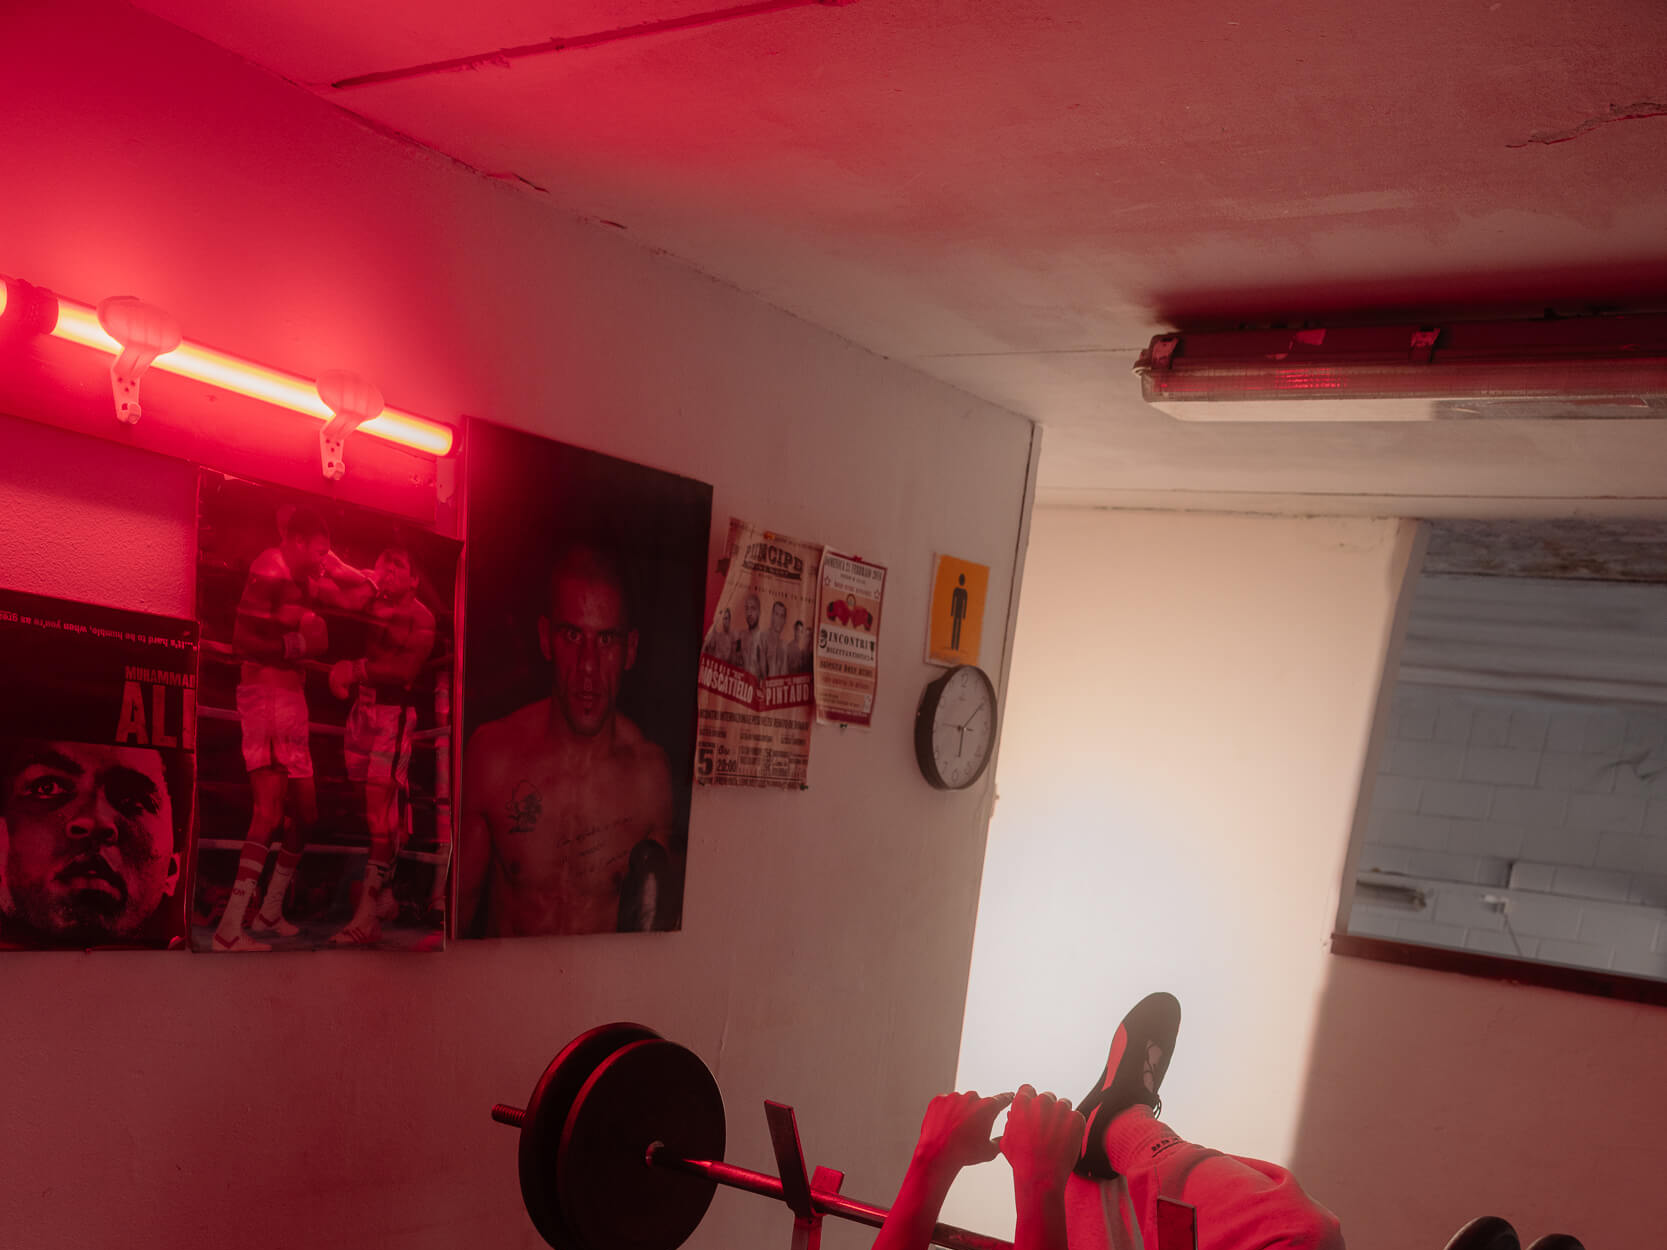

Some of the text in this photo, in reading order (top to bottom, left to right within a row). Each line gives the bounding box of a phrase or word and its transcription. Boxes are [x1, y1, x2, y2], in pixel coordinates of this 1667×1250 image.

[20, 615, 31, 624] as
[63, 623, 87, 634] when
[126, 631, 136, 642] be
[138, 634, 146, 644] to
[148, 635, 168, 647] hard
[125, 665, 196, 689] MUHAMMAD
[115, 680, 196, 750] ALI
[698, 748, 714, 776] 5
